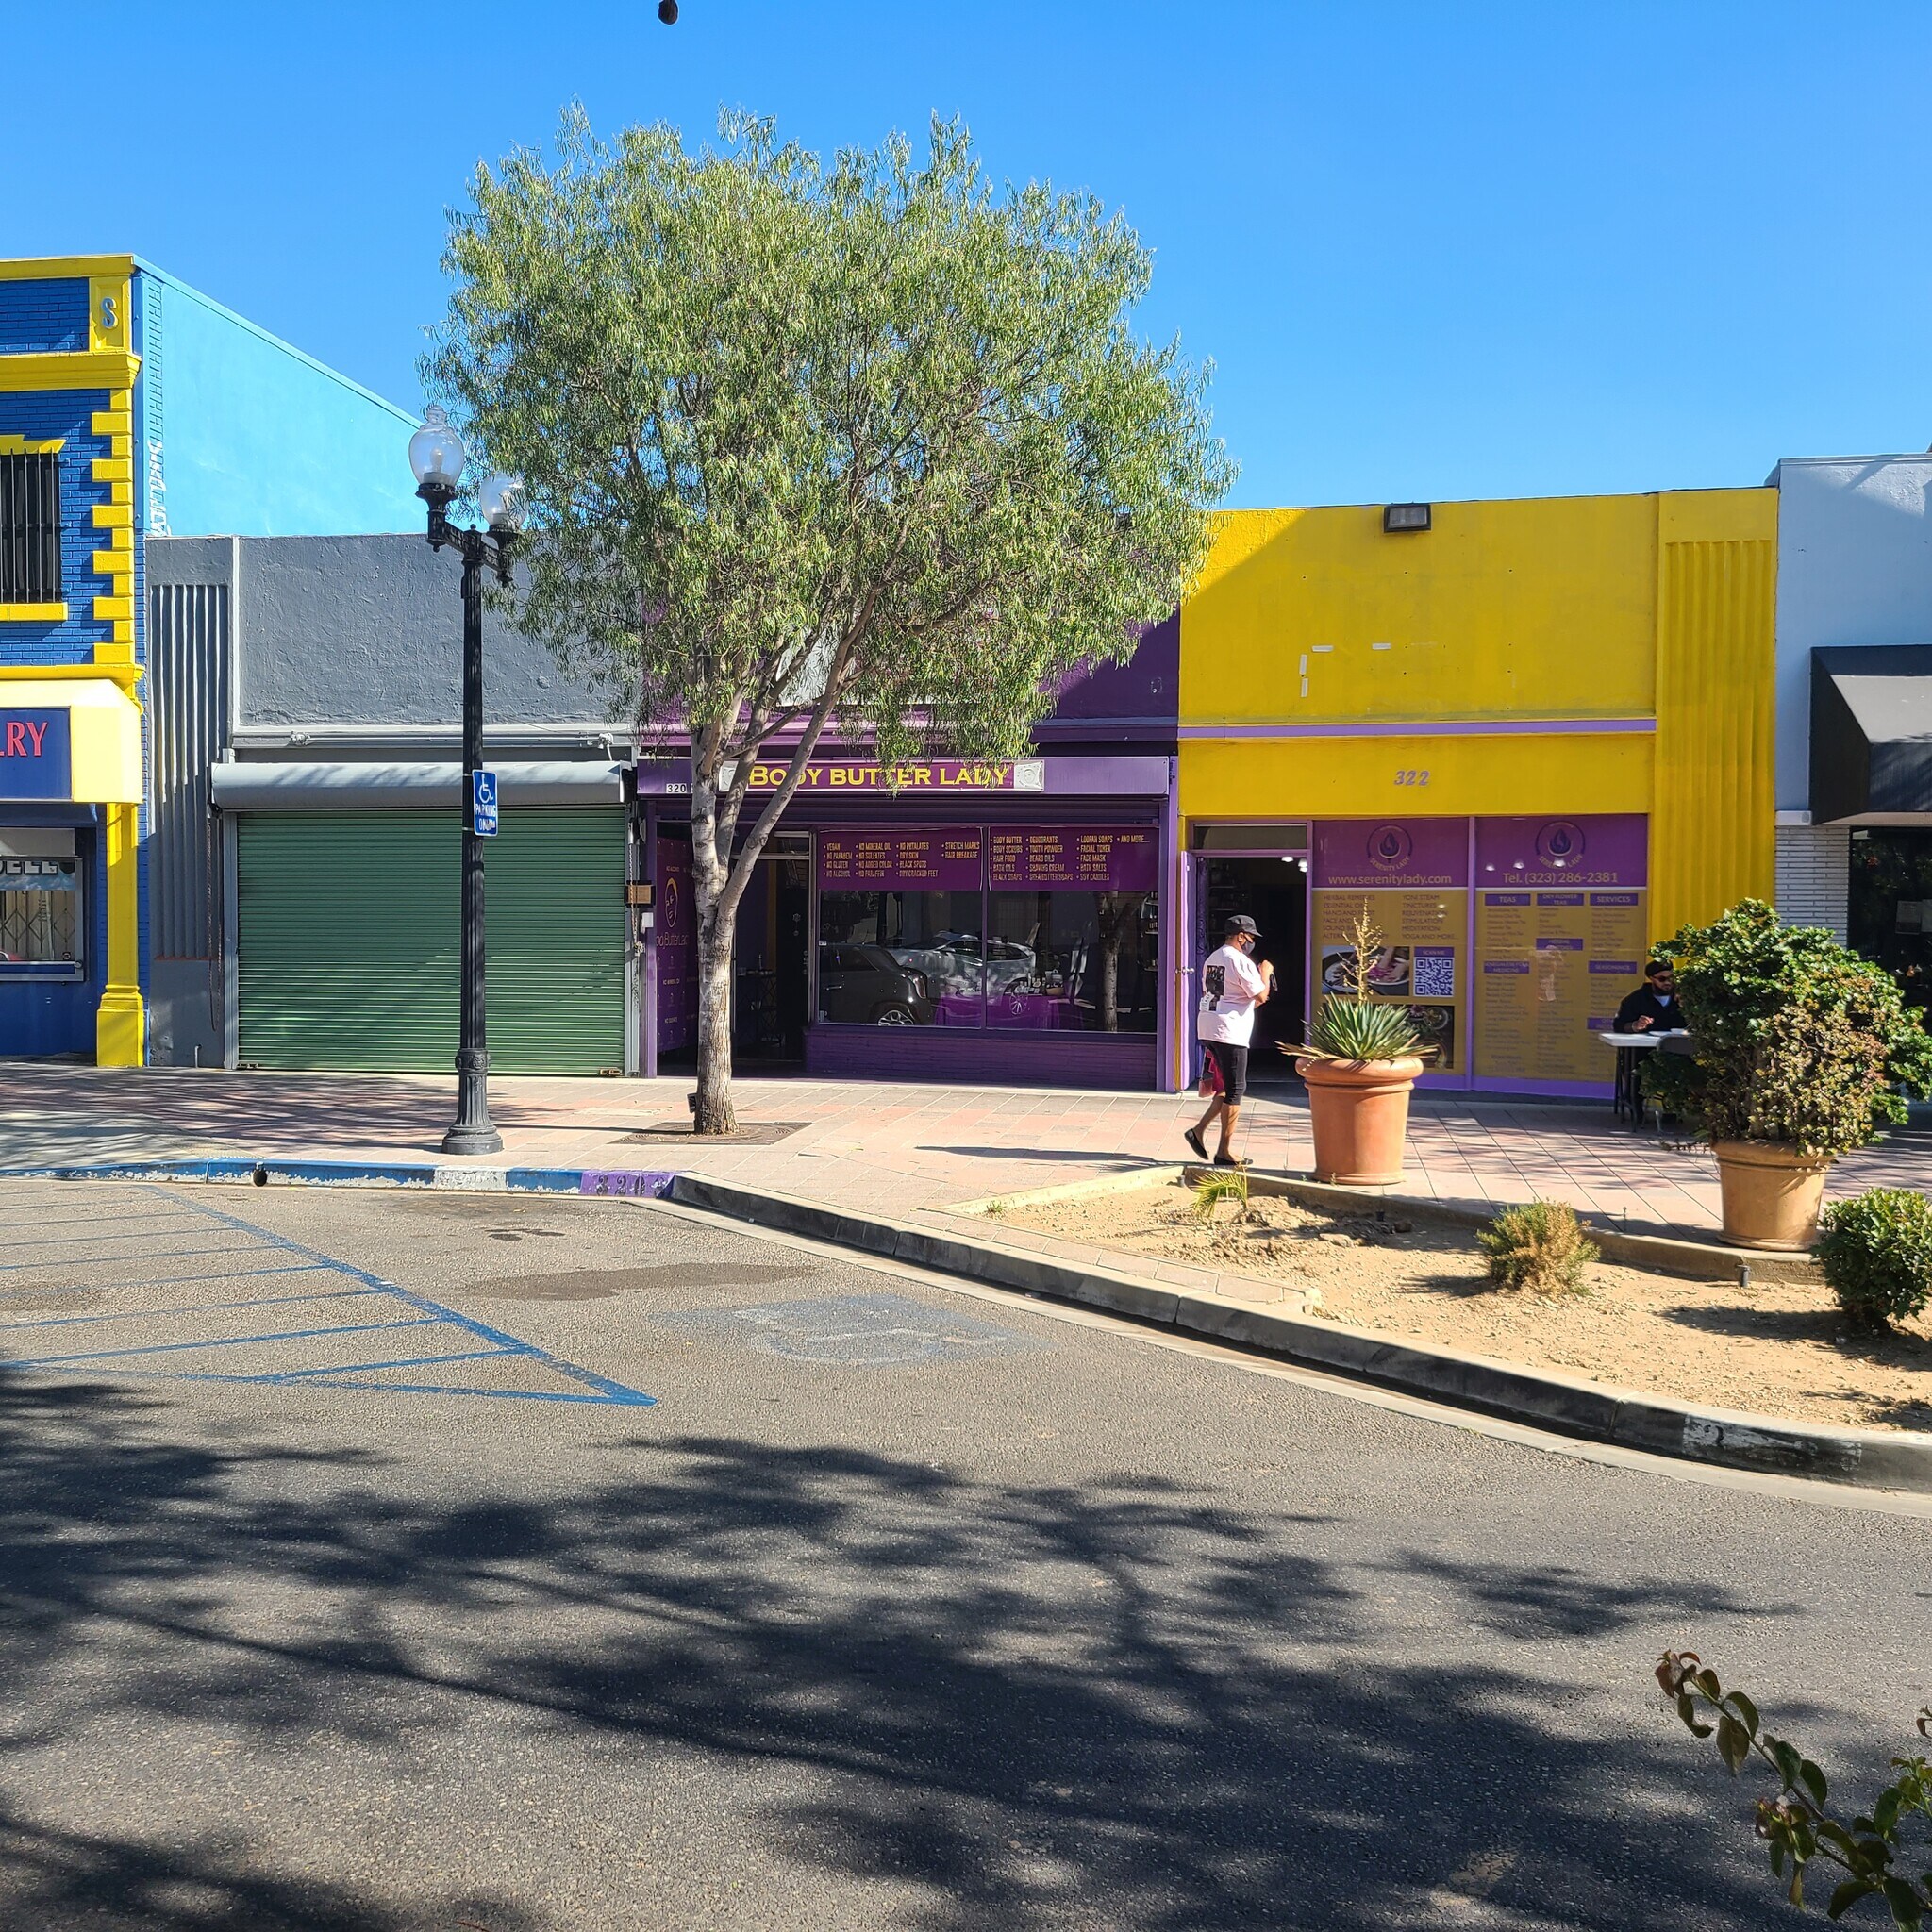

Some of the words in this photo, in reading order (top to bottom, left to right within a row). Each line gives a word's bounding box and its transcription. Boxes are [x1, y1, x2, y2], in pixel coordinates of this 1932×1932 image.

[101, 297, 117, 329] S
[0, 721, 48, 757] RY
[1393, 770, 1430, 786] 322
[667, 784, 687, 793] 320
[475, 804, 496, 817] PARKING
[993, 836, 1005, 844] BODY
[1006, 836, 1023, 844] BUTTER
[1098, 835, 1114, 843] SOAPS
[1120, 835, 1130, 843] AND
[826, 842, 841, 851] VEGAN
[858, 842, 865, 851] NO
[865, 842, 884, 851] MINERAL
[899, 841, 906, 850] NO
[944, 841, 964, 850] STRETCH
[964, 841, 980, 850] MARKS
[826, 851, 832, 859] NO
[858, 851, 865, 859] NO
[899, 851, 908, 859] DRY
[908, 851, 919, 859] SKIN
[944, 851, 956, 859] HAIR
[993, 854, 1004, 862] HAIR
[1005, 854, 1016, 862] FOOD
[1029, 854, 1043, 862] BEARD
[1044, 854, 1055, 862] OILS
[1080, 854, 1091, 862] FACE
[1092, 854, 1107, 862] MASK
[858, 860, 865, 869] NO
[899, 860, 913, 869] BLACK
[913, 860, 927, 869] SPOTS
[1370, 858, 1395, 871] SERENITY
[1396, 856, 1409, 869] LADY
[1567, 853, 1583, 868] LADY
[1049, 863, 1065, 872] CREAM
[1092, 863, 1107, 872] SALTS
[927, 869, 939, 877] FEET
[1328, 874, 1452, 886] www.serenitylady.com
[1502, 873, 1522, 883] Tel.
[1524, 873, 1556, 885] (323)
[1558, 872, 1618, 883] 286-2381
